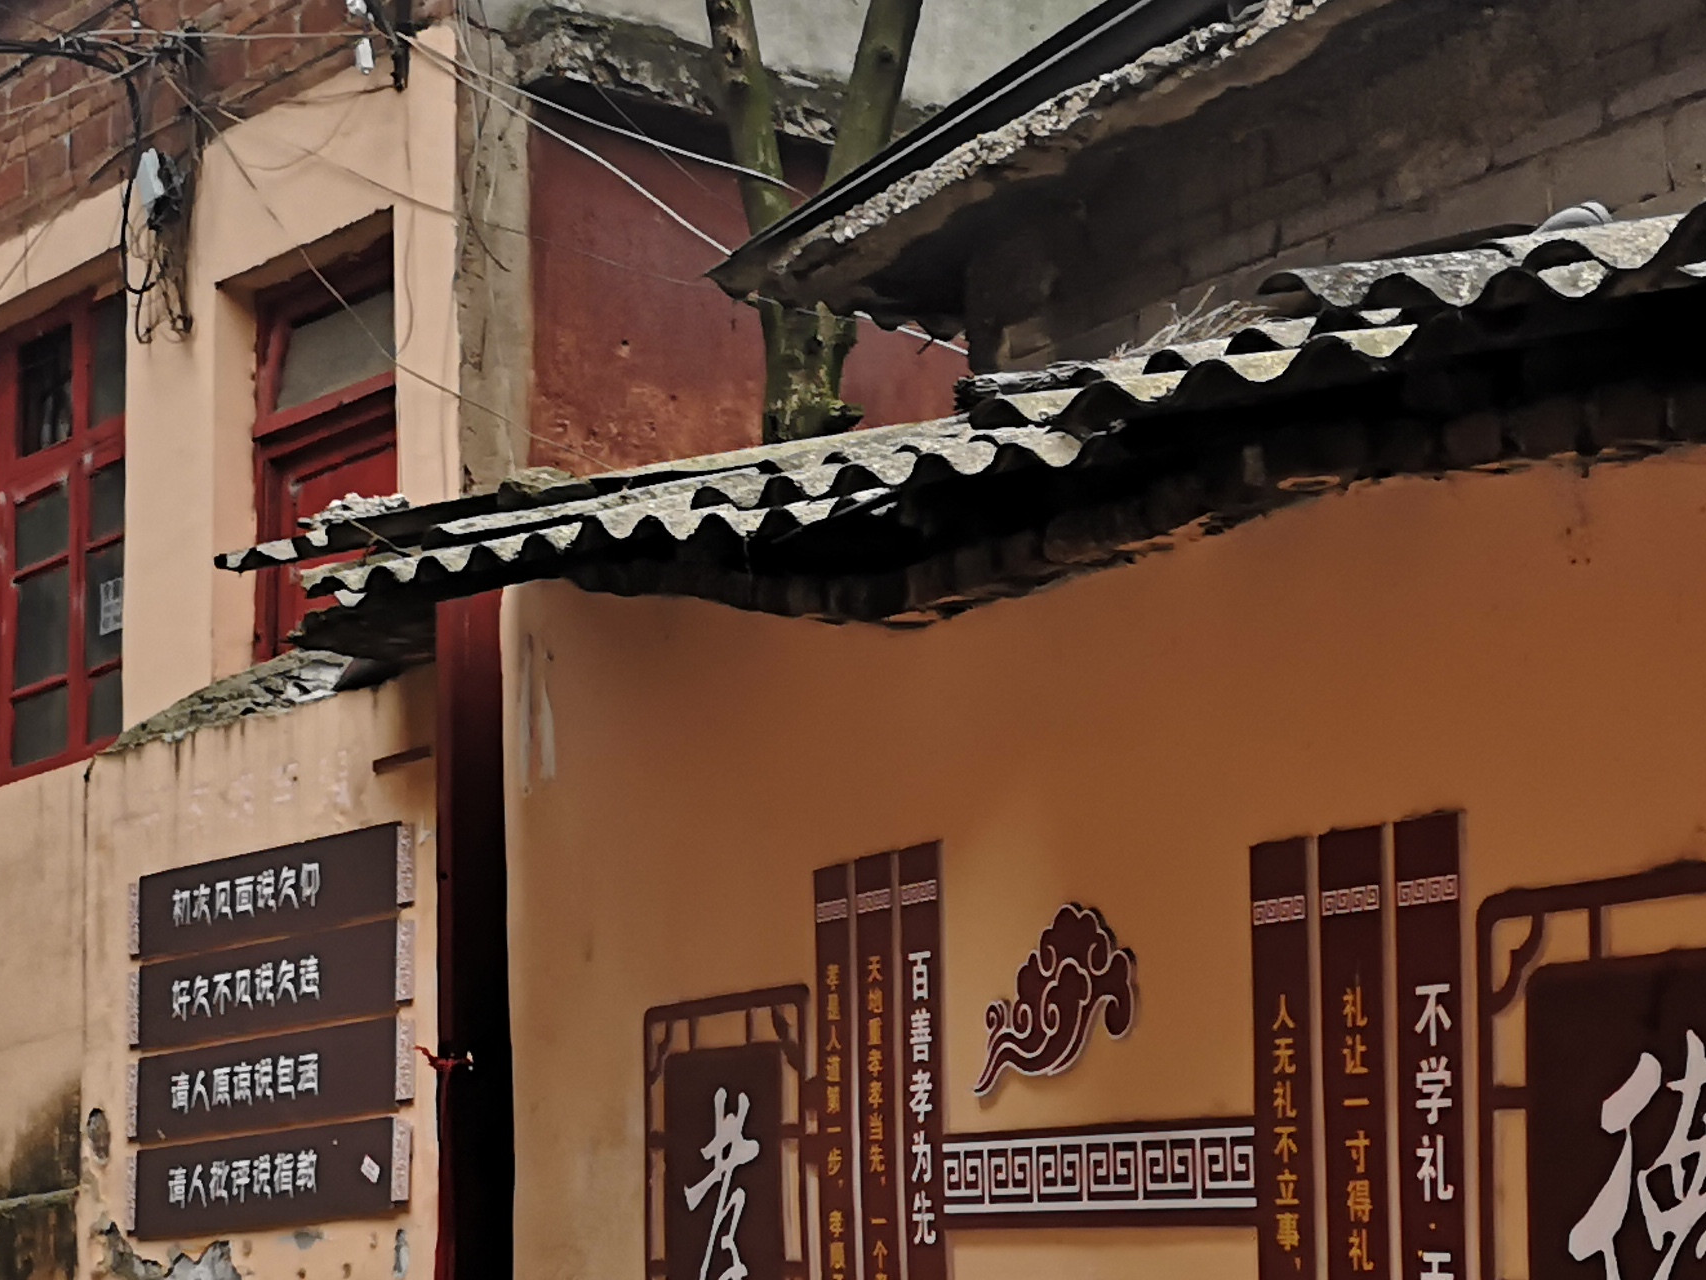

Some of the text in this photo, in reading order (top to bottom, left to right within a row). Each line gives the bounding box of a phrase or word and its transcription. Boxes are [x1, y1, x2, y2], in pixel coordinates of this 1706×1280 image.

[171, 862, 321, 928] 初次见面说久仰
[171, 954, 321, 1022] 好久不见说久违
[170, 1052, 319, 1114] 请人原谅说包涵
[907, 950, 937, 1246] 百善孝为先
[168, 1148, 318, 1209] 请人批评说指教
